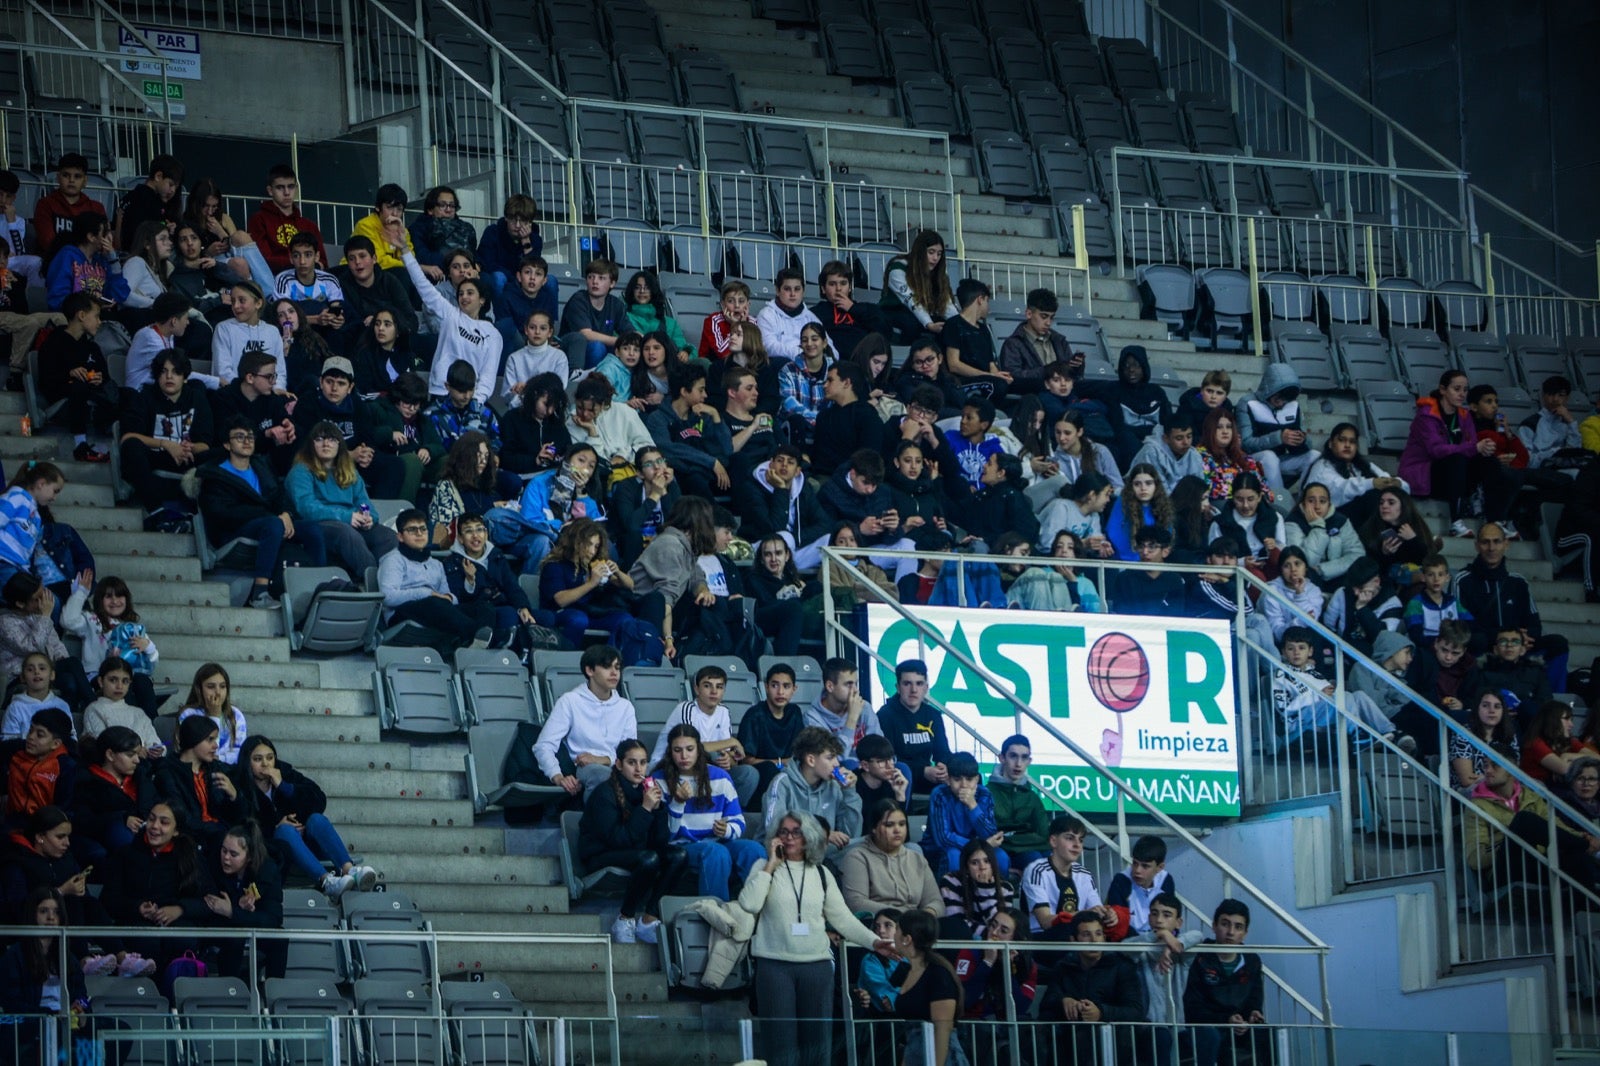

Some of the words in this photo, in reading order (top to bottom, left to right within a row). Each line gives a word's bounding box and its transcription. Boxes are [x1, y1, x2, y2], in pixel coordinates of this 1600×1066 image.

[157, 33, 186, 48] PAR
[145, 83, 181, 98] SALDA
[902, 731, 931, 745] PUMA
[1138, 729, 1229, 757] limpieza
[1039, 774, 1091, 801] POR
